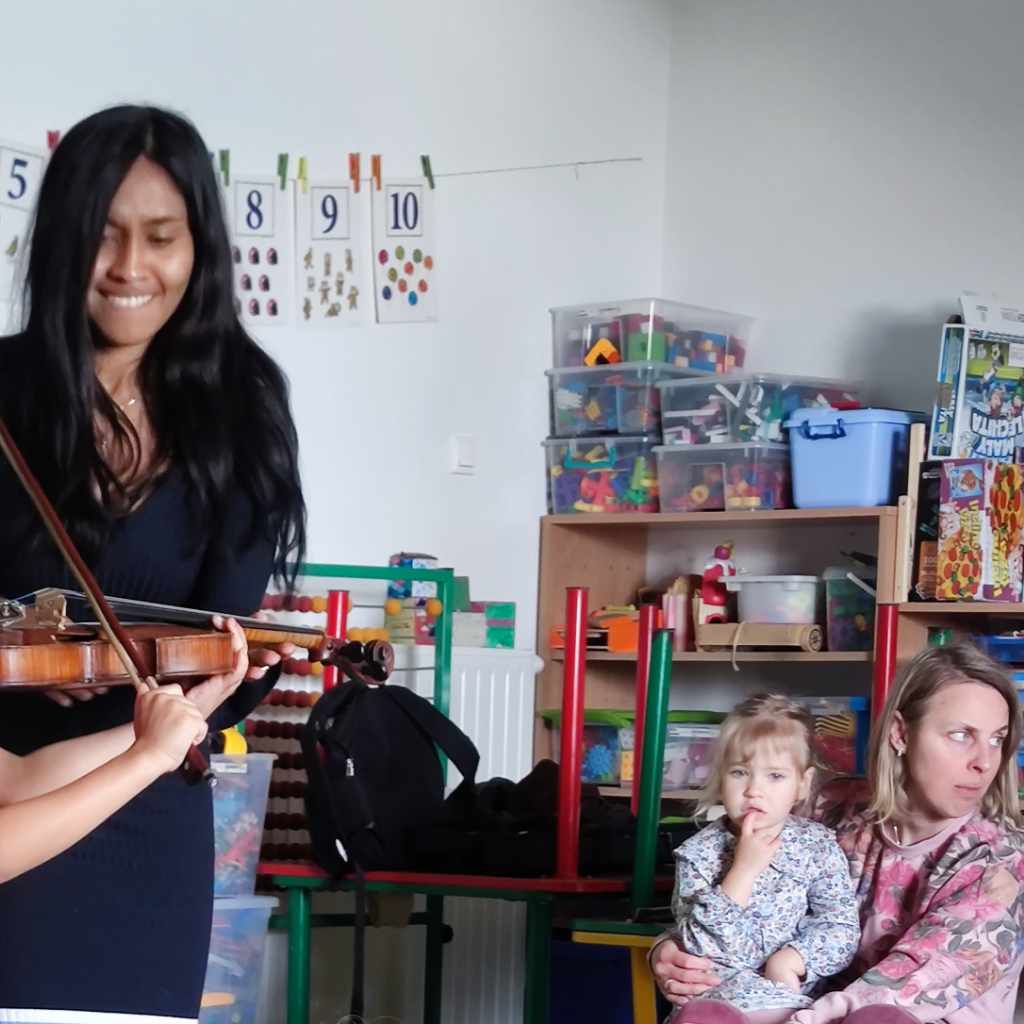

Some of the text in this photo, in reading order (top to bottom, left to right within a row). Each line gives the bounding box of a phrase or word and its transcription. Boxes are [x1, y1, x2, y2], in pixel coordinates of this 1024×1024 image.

[7, 158, 28, 200] 5
[245, 189, 264, 230] 8
[320, 194, 339, 234] 9
[390, 191, 419, 230] 10
